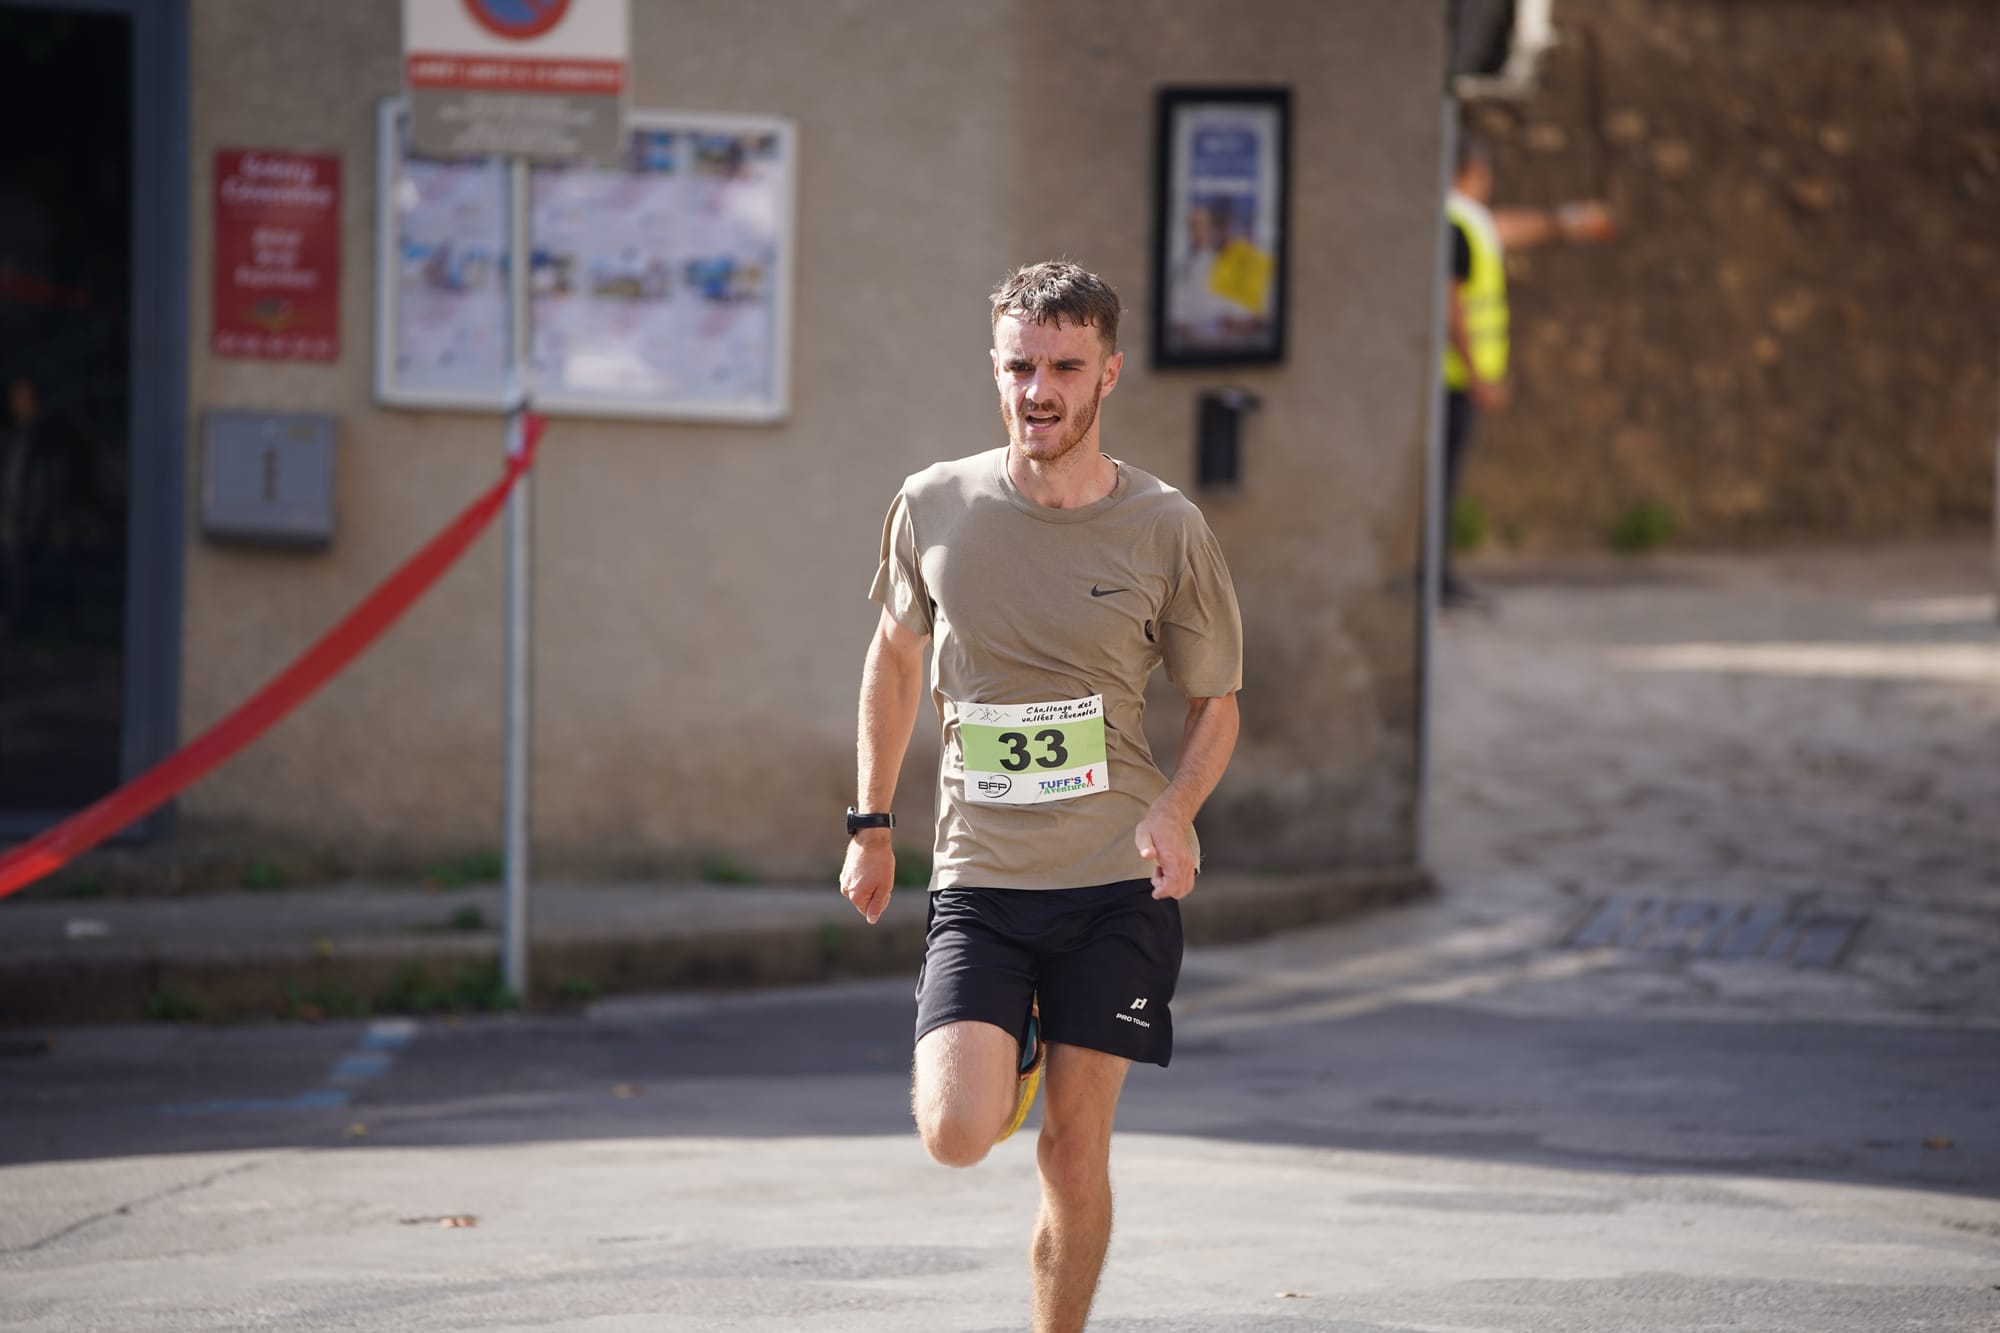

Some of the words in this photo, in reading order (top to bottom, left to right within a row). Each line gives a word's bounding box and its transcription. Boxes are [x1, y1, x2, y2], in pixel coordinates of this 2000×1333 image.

[1026, 705, 1072, 714] Challenge
[1078, 701, 1092, 709] des
[1021, 714, 1054, 722] vallées
[1059, 708, 1097, 720] cévenoles
[998, 729, 1069, 772] 33
[978, 781, 1007, 791] BFP
[1038, 776, 1082, 790] TUFF'S
[1044, 783, 1086, 795] Aventure
[1115, 1013, 1133, 1022] PRO
